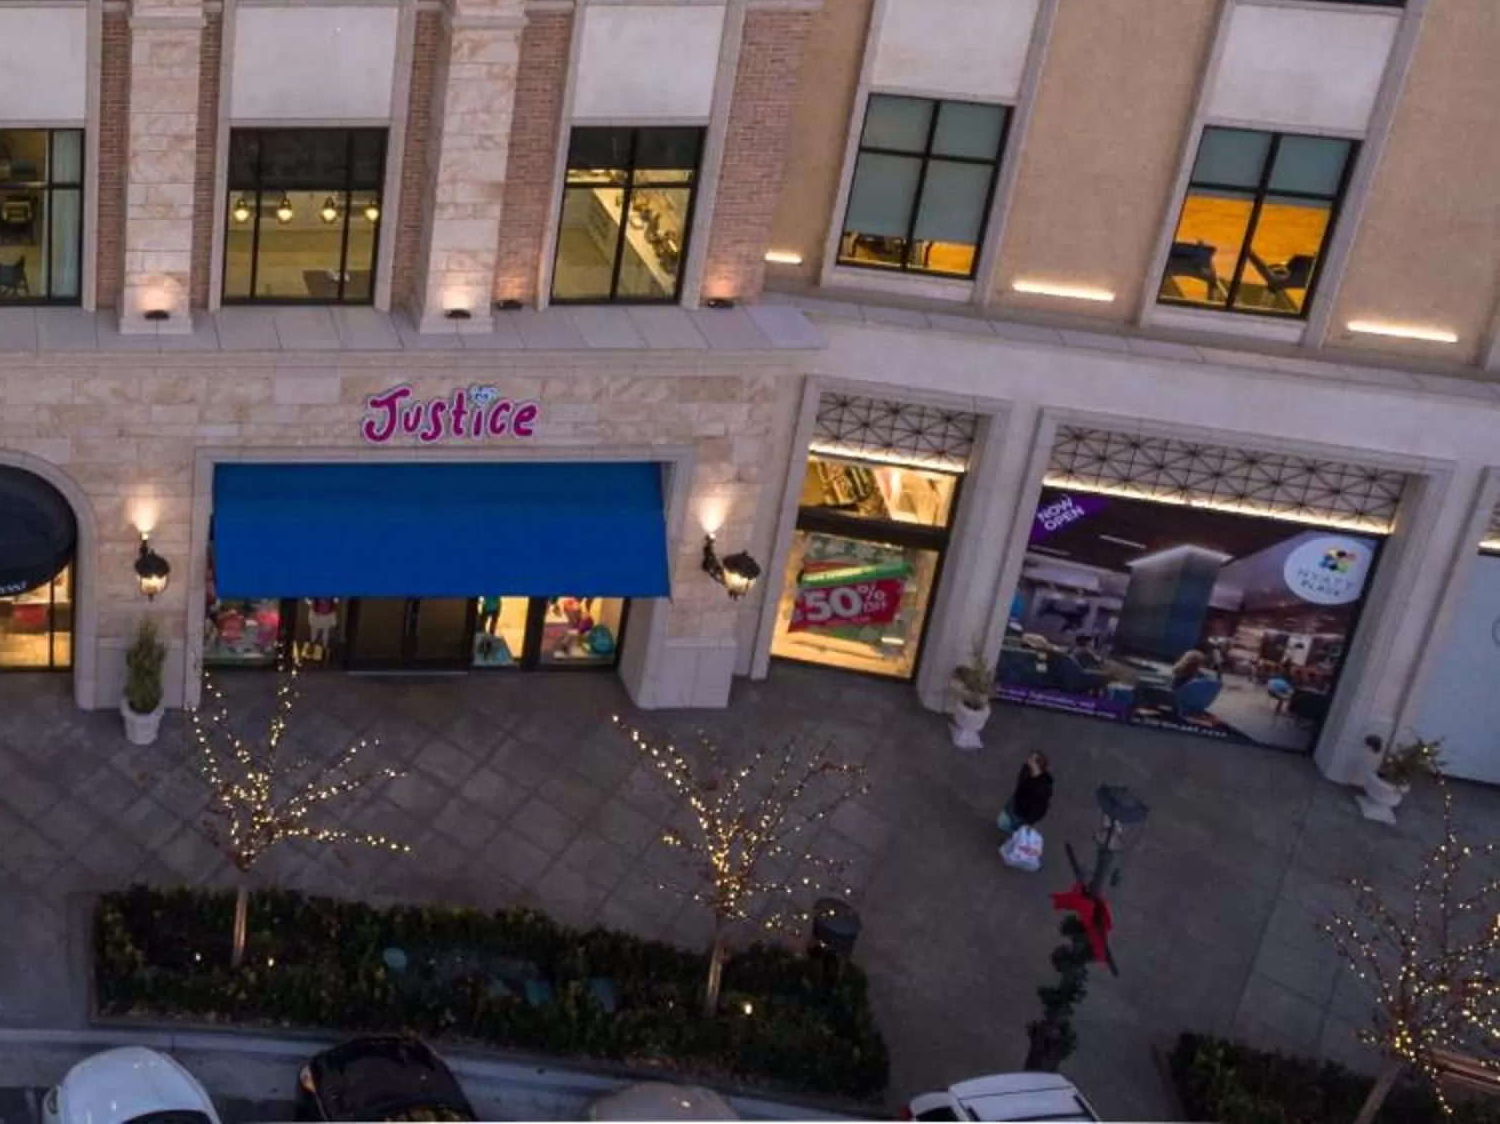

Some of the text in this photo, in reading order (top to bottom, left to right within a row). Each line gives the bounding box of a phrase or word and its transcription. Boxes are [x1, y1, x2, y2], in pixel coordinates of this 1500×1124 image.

[363, 385, 540, 445] Justice
[1037, 497, 1073, 524] NOW
[1044, 505, 1085, 532] OPEN
